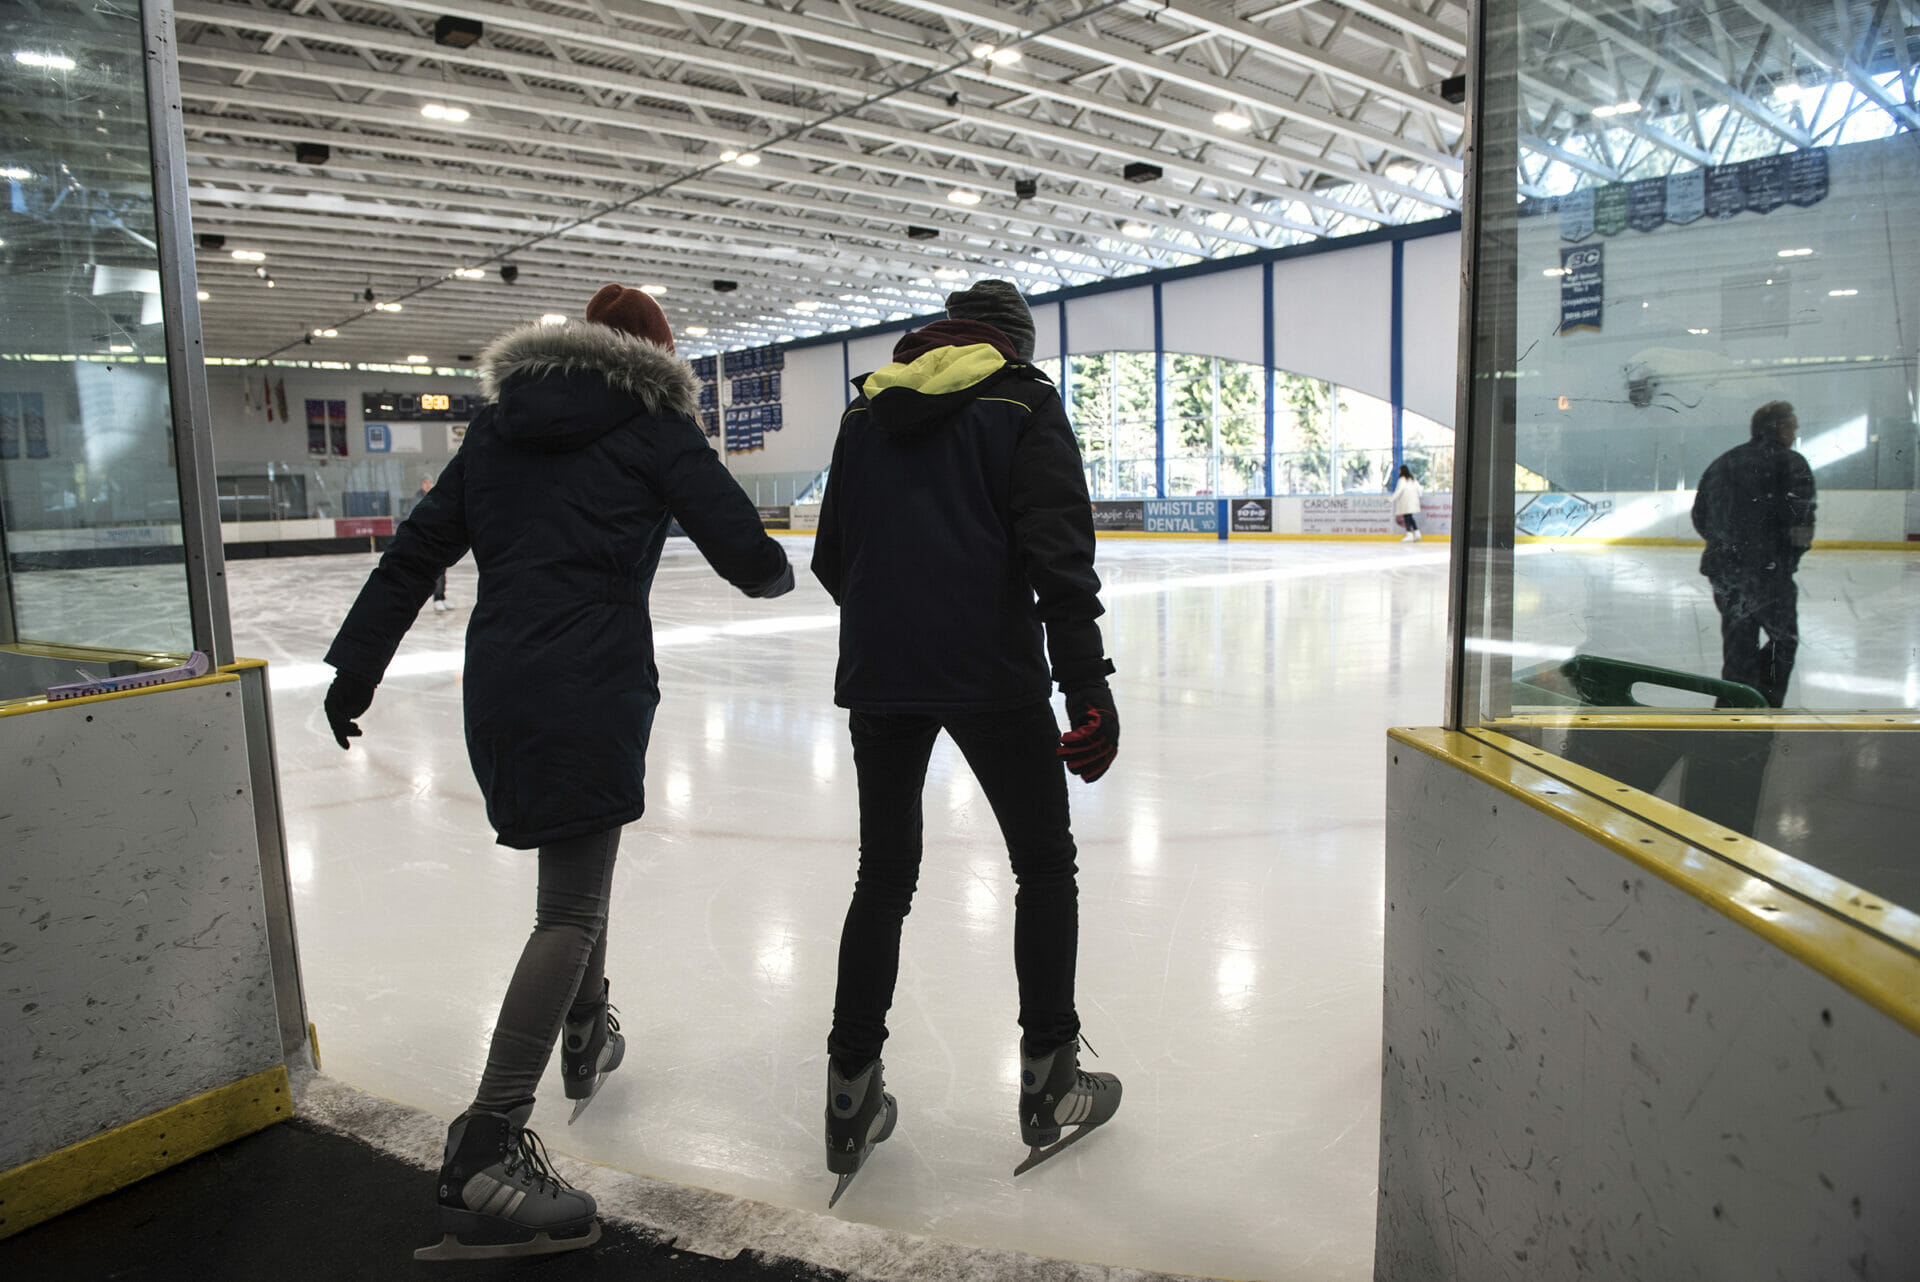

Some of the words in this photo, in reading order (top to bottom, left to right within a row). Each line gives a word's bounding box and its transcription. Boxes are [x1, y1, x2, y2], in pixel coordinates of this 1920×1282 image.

[1147, 502, 1215, 516] WHISTLER
[1303, 499, 1348, 510] CARONNE
[1148, 519, 1198, 532] DENTAL
[578, 1064, 588, 1076] G
[1030, 1113, 1039, 1127] A
[846, 1137, 855, 1151] A
[439, 1184, 448, 1198] G
